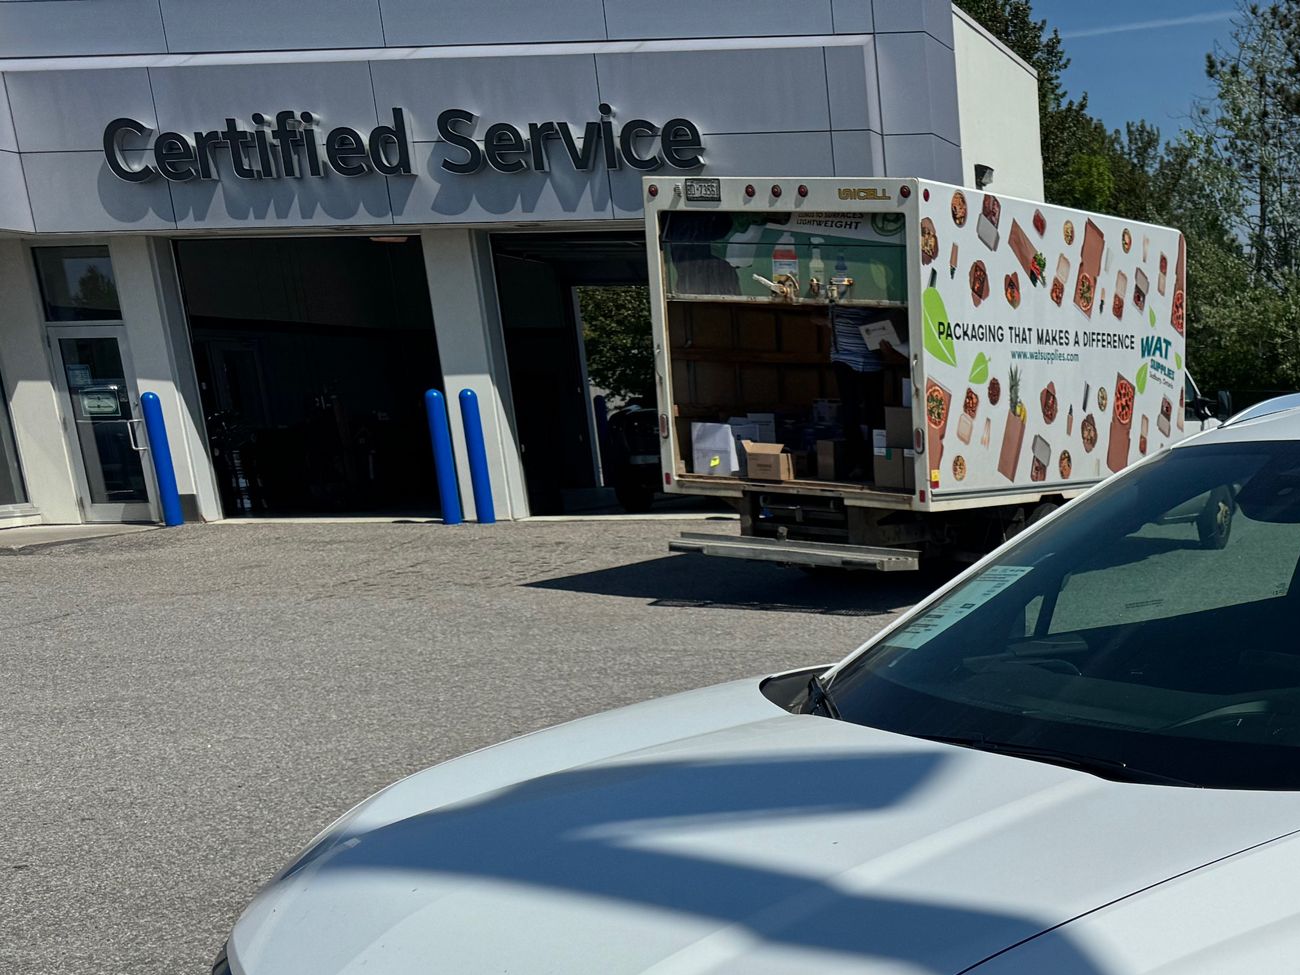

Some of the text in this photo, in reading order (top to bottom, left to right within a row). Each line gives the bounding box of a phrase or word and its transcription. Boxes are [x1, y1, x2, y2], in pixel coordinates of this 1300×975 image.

[102, 103, 706, 183] Certified Service
[838, 188, 891, 200] UNICELL
[796, 219, 862, 230] LIGHTWEIGHT
[938, 321, 1135, 350] PACKAGING THAT MAKES A DIFFERENCE
[1010, 349, 1080, 364] www.watsupplies.com
[1140, 335, 1172, 360] WAT
[1150, 358, 1175, 381] SUPPLIES
